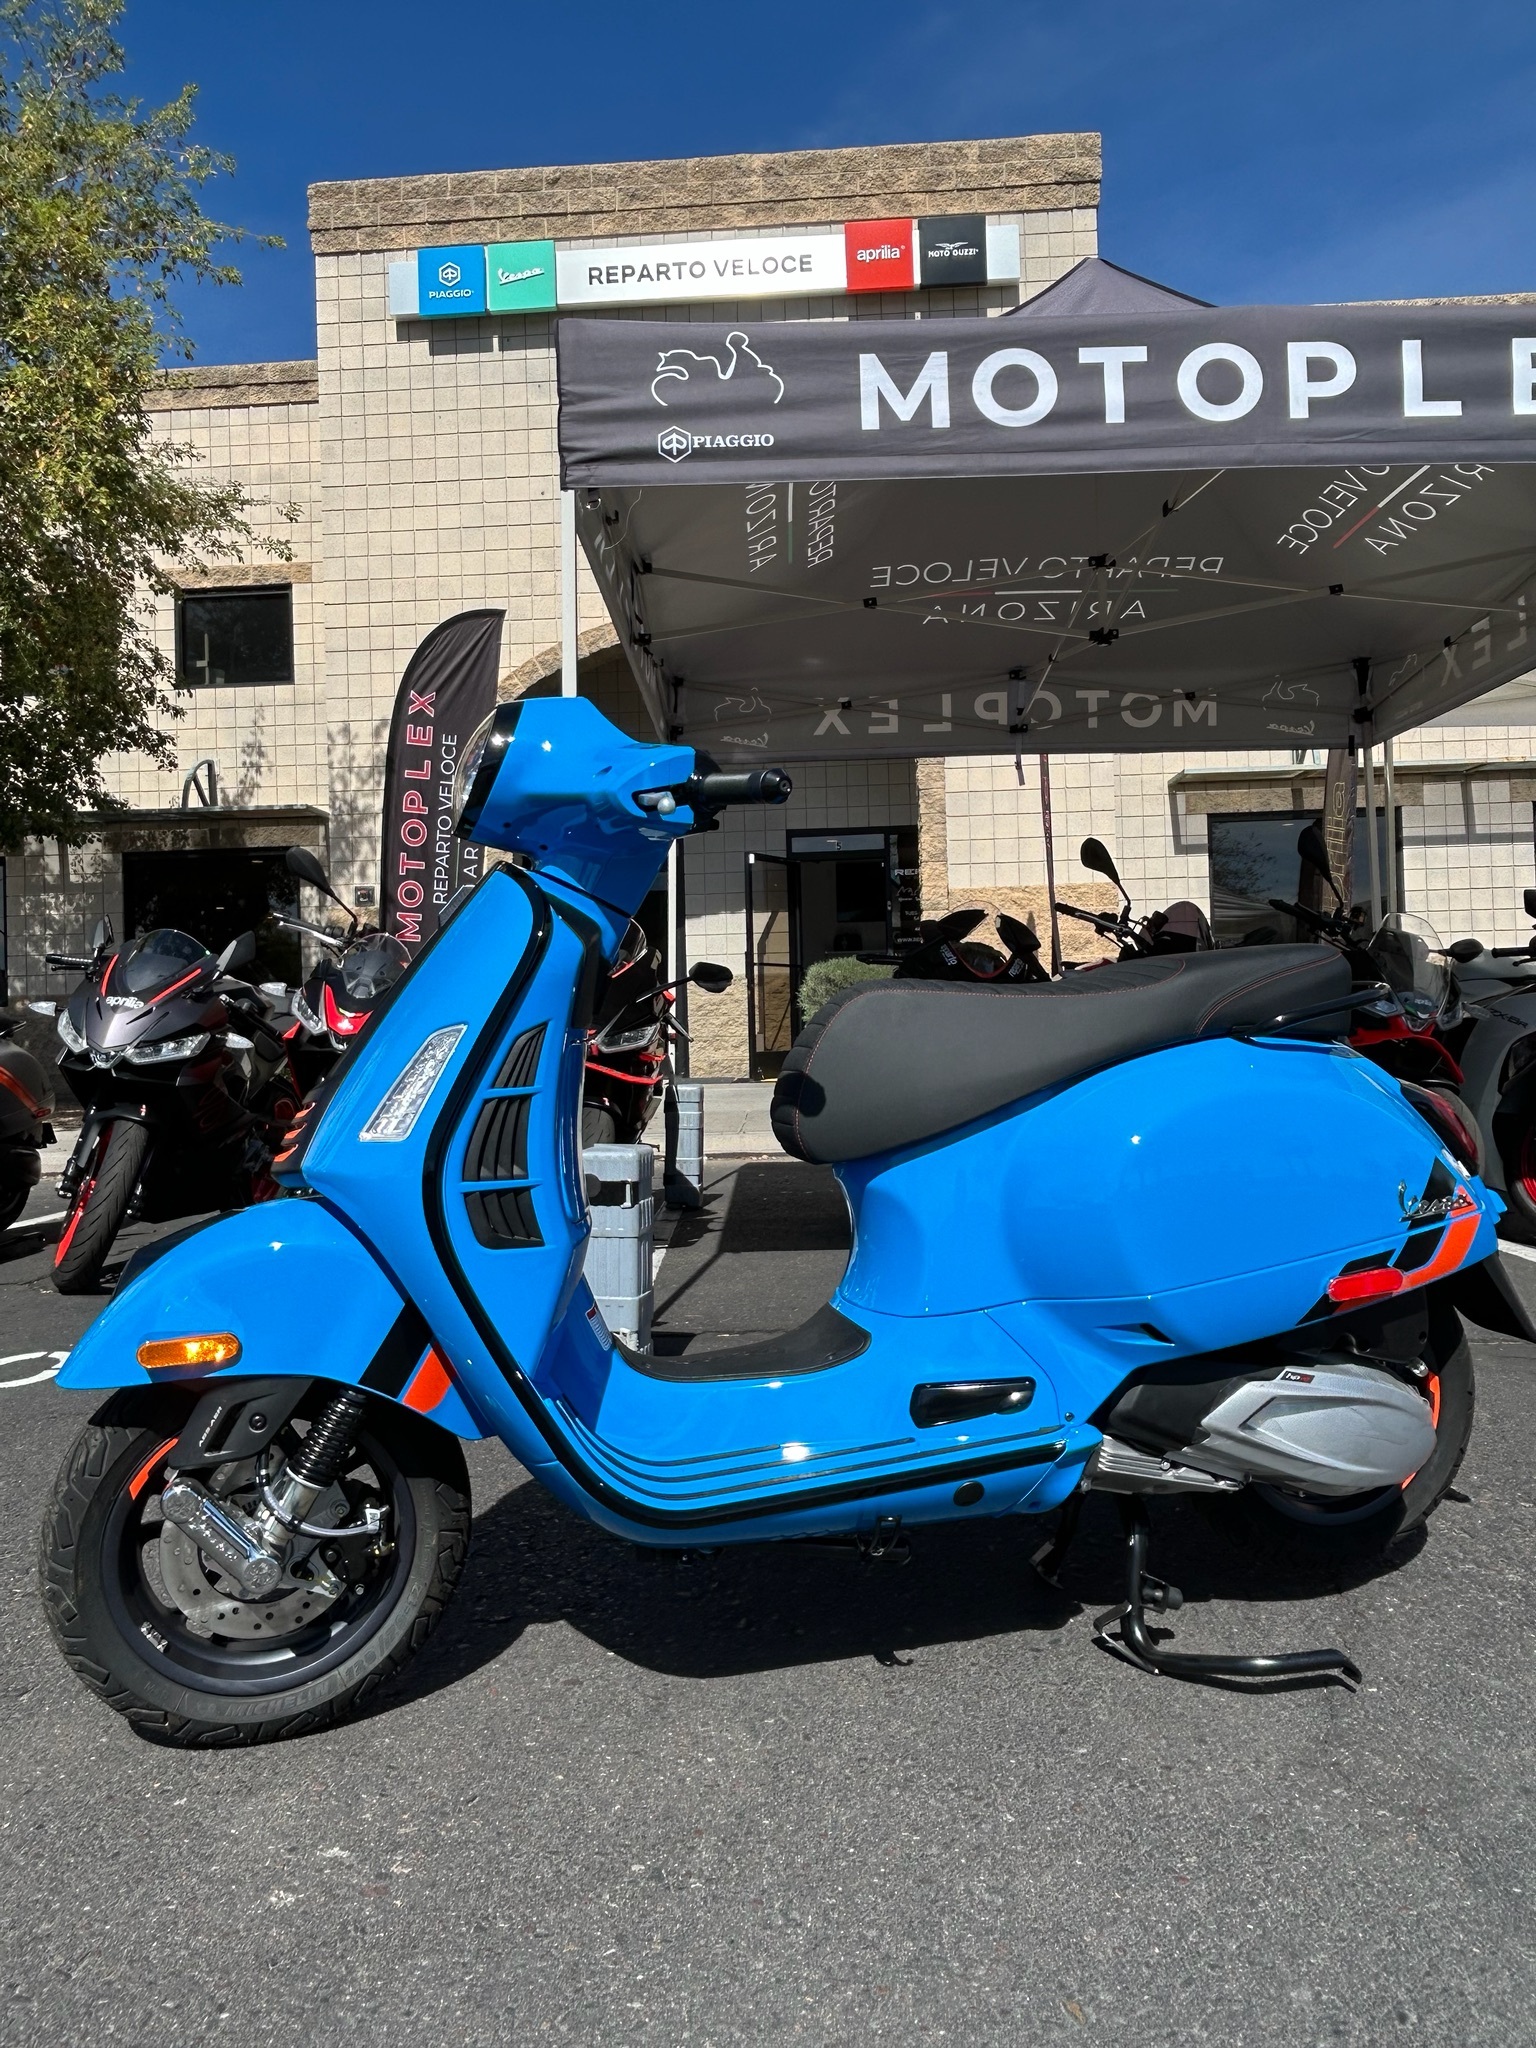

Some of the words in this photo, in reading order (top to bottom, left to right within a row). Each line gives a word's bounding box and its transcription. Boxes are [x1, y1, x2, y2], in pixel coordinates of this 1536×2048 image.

[857, 244, 900, 262] aprilia
[928, 250, 950, 258] MOTO
[952, 248, 976, 257] GUZZI
[498, 267, 545, 286] Vespa
[588, 261, 706, 286] REPARTO
[713, 253, 813, 277] VELOCE
[428, 288, 473, 299] PIAGGIO
[693, 433, 775, 450] PIAGGIO
[394, 690, 437, 942] MOTOPLEX
[433, 815, 453, 904] REPARTO
